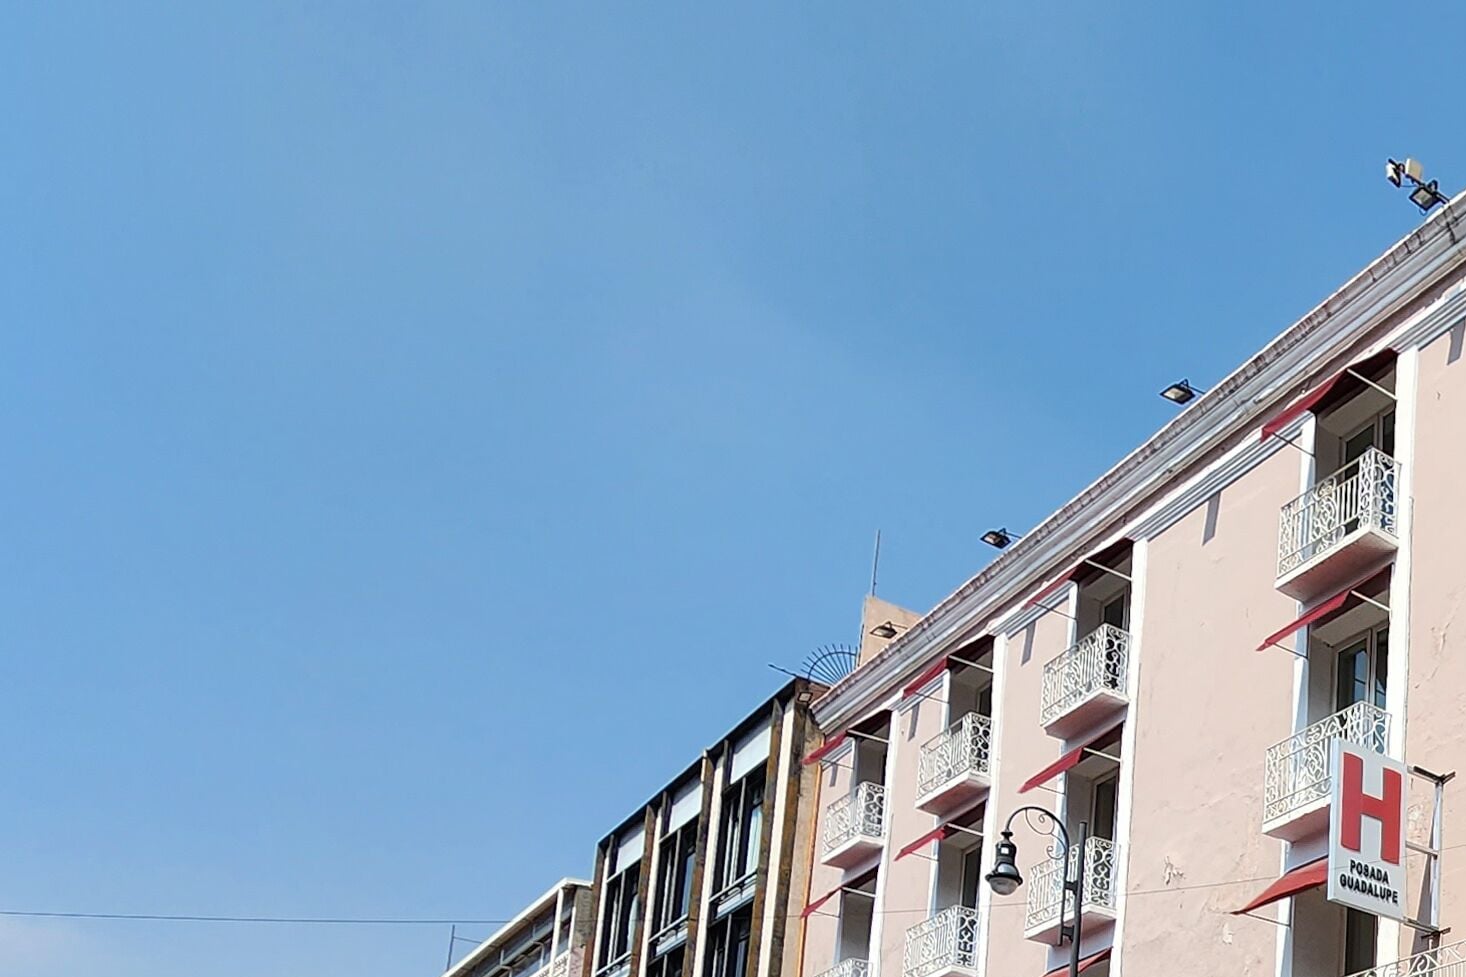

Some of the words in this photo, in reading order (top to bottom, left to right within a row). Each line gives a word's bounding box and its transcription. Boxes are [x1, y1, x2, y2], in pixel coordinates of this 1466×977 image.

[1341, 752, 1402, 866] H
[1350, 859, 1389, 884] POSADA
[1340, 874, 1398, 904] GUADALUPE
